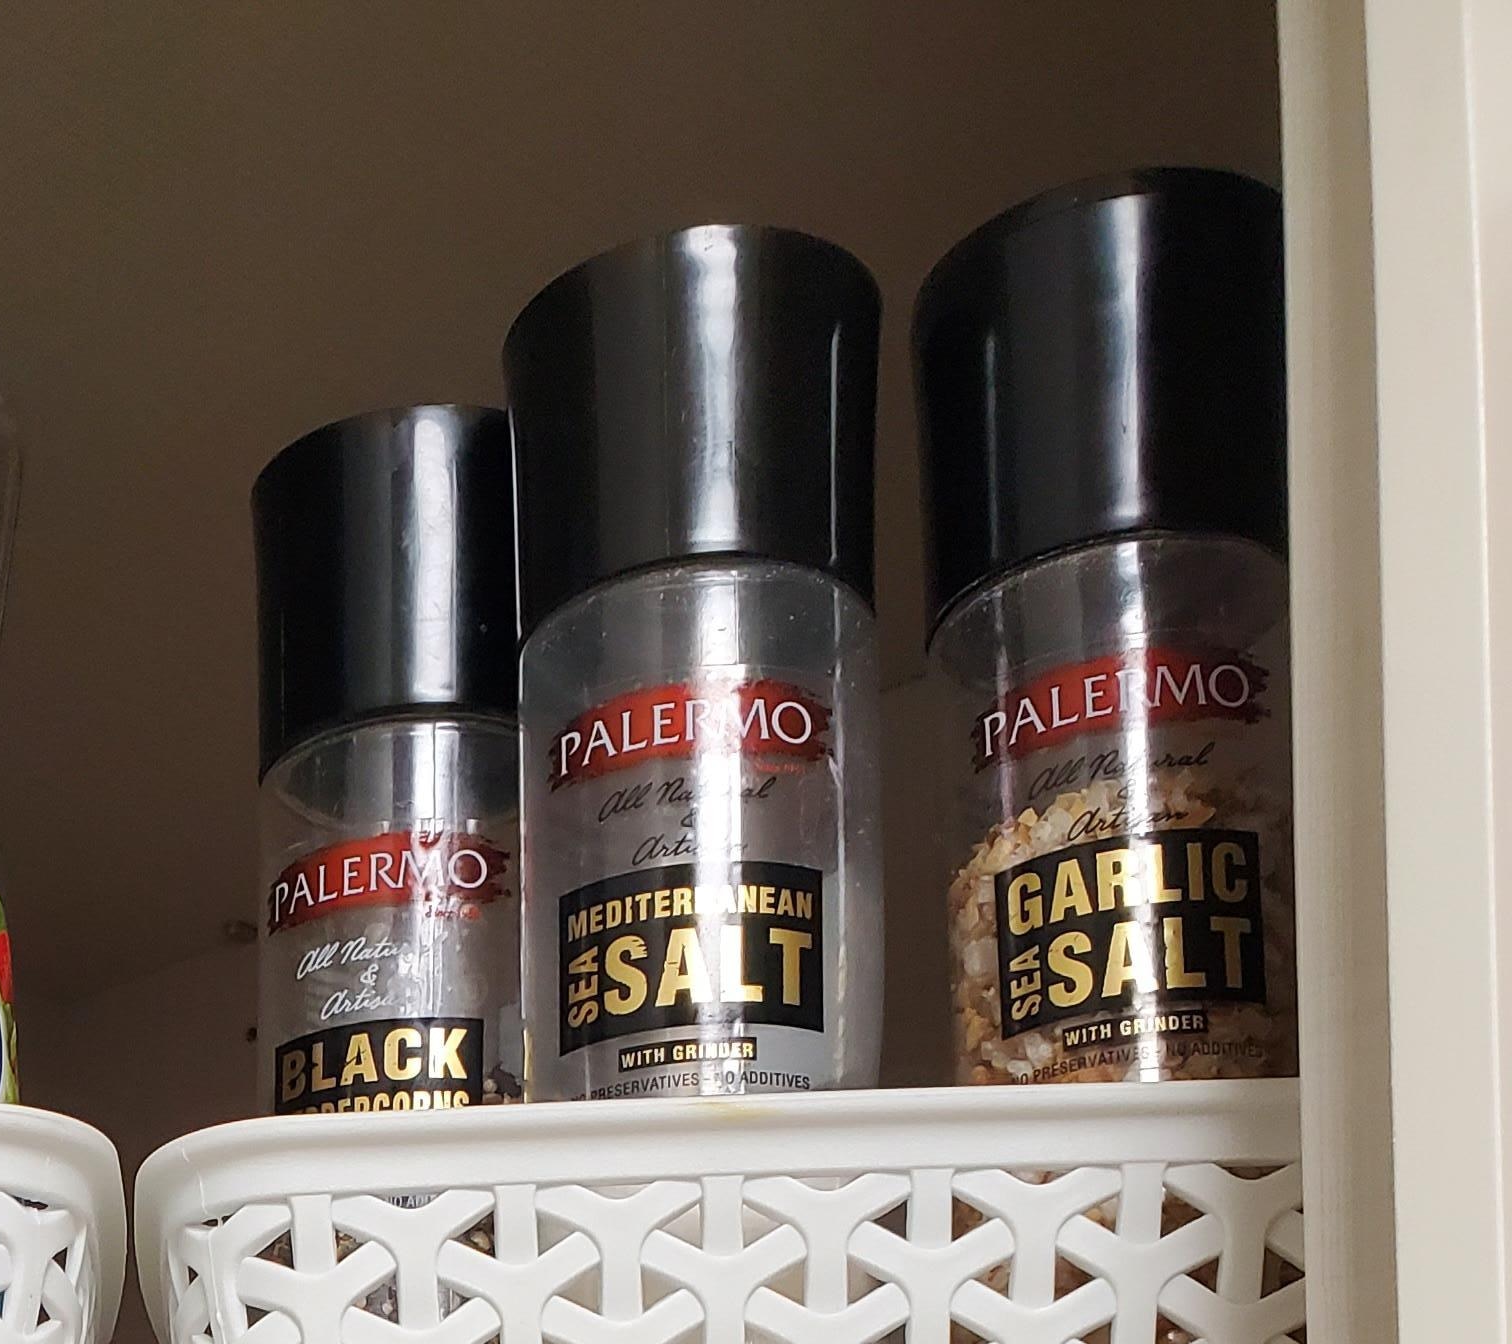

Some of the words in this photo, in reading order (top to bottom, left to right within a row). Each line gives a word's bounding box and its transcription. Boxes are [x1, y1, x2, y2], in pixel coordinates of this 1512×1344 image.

[558, 697, 814, 778] PALERMO
[983, 662, 1251, 758] PALERMO
[599, 781, 652, 823] All
[1029, 754, 1088, 801] All
[273, 848, 488, 924] PALERMO
[1007, 841, 1248, 938] GARLIC
[296, 941, 340, 980] All
[568, 945, 600, 1030] SEA
[604, 924, 813, 1017] SALT
[1011, 944, 1043, 1022] SEA
[1047, 916, 1252, 1008] SALT
[280, 1027, 469, 1103] BLACK
[620, 1046, 665, 1069] WITH
[673, 1042, 754, 1061] GRINDER
[1064, 1023, 1112, 1047] WITH
[1120, 1014, 1206, 1038] GRINDER
[739, 1071, 811, 1090] ADDITIVES
